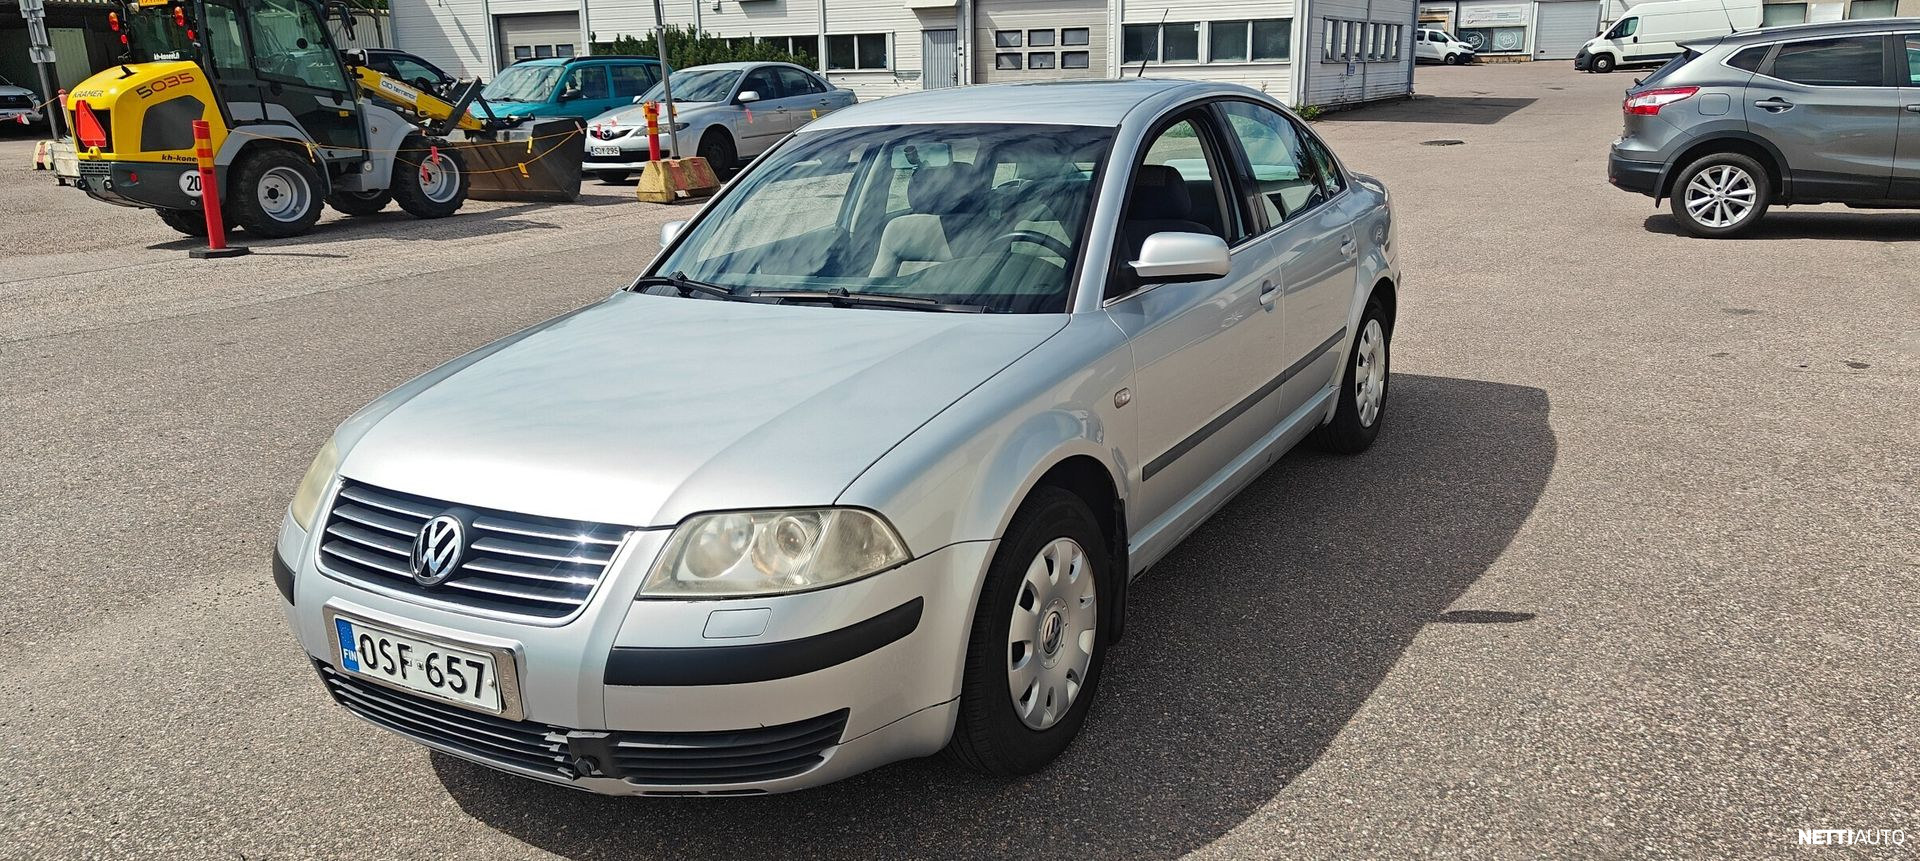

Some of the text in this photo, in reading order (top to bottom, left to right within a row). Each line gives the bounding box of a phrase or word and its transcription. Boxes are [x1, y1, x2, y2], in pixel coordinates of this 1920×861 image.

[136, 72, 195, 99] 5035
[72, 90, 104, 98] KRAMER
[186, 175, 202, 191] 20
[343, 648, 358, 662] FIN
[359, 633, 486, 699] OSF-657
